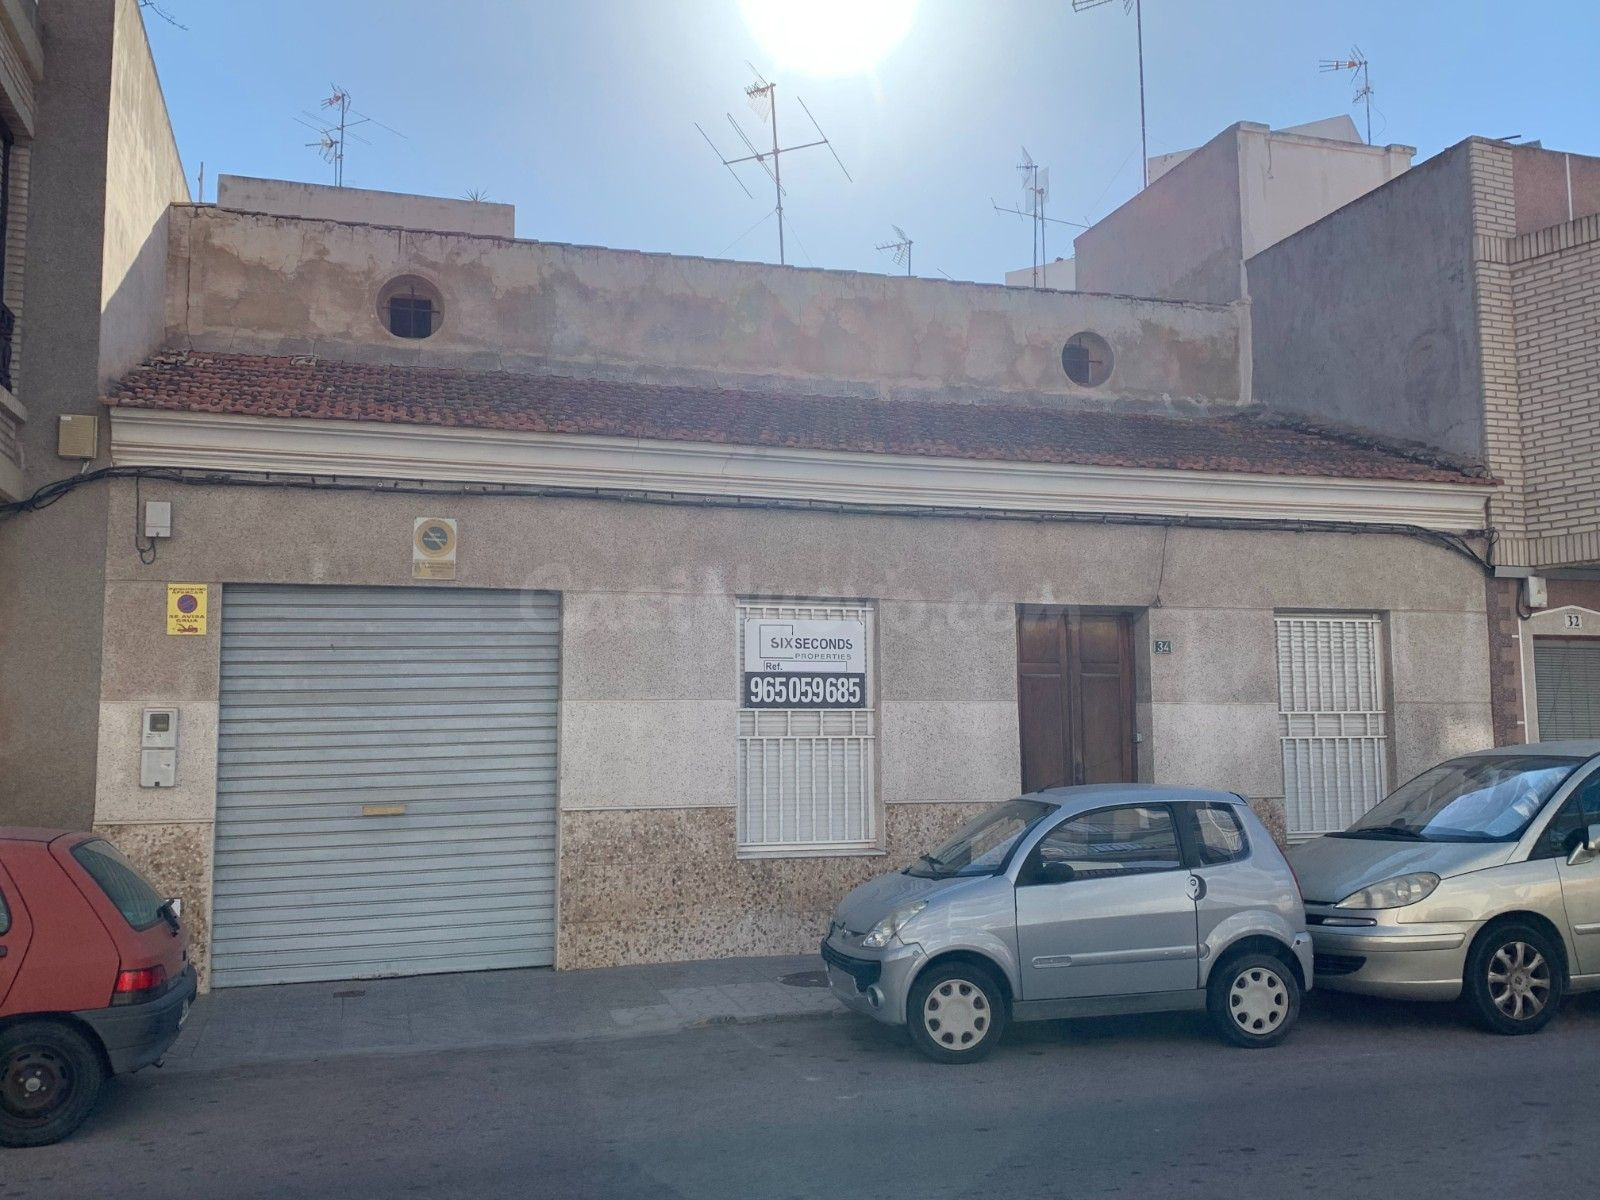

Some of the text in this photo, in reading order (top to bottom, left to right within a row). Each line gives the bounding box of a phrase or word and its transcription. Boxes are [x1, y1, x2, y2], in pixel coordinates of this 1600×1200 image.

[1567, 615, 1580, 627] 32
[1157, 641, 1169, 652] 34
[794, 652, 852, 660] PROPERTIES
[765, 662, 783, 671] Ref.
